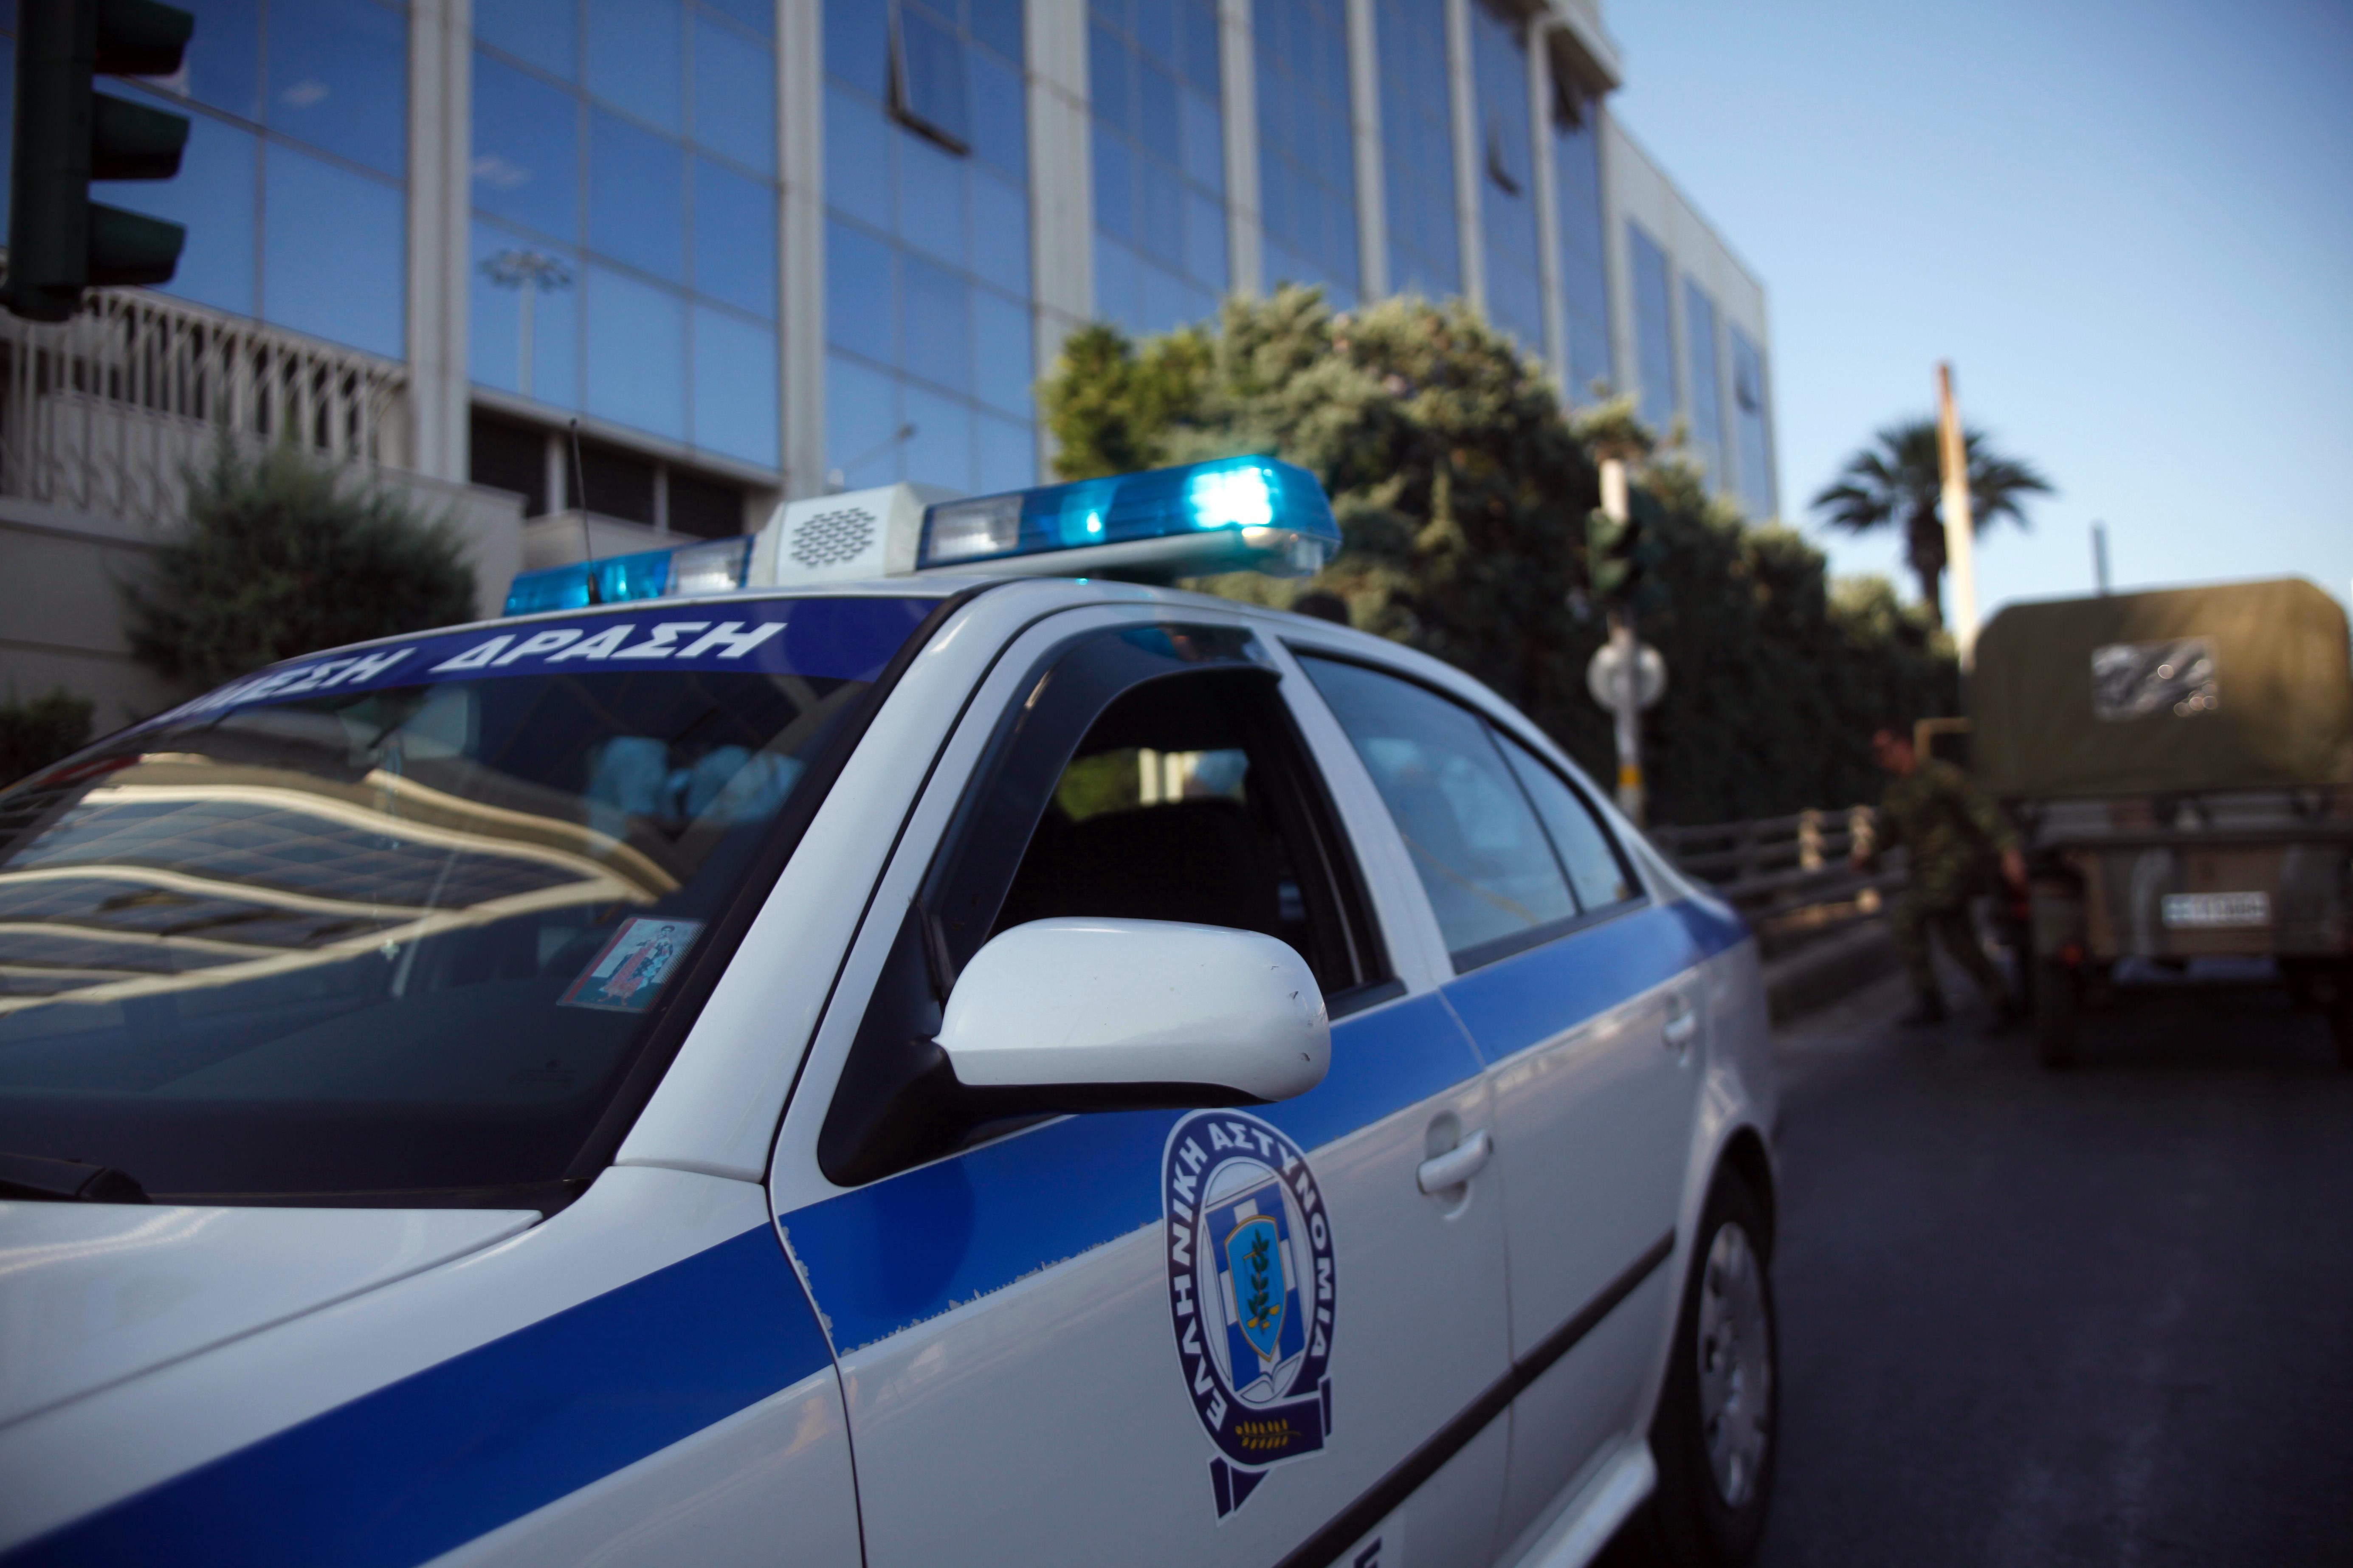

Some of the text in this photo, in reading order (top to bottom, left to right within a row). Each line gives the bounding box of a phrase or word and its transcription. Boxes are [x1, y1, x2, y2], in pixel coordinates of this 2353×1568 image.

[428, 621, 789, 674] ΔΡΑΣΗ
[1172, 1121, 1332, 1432] ΕΛΛΗΝΙΚΗ ΑΣΤΥΝΟΜΙΑ
